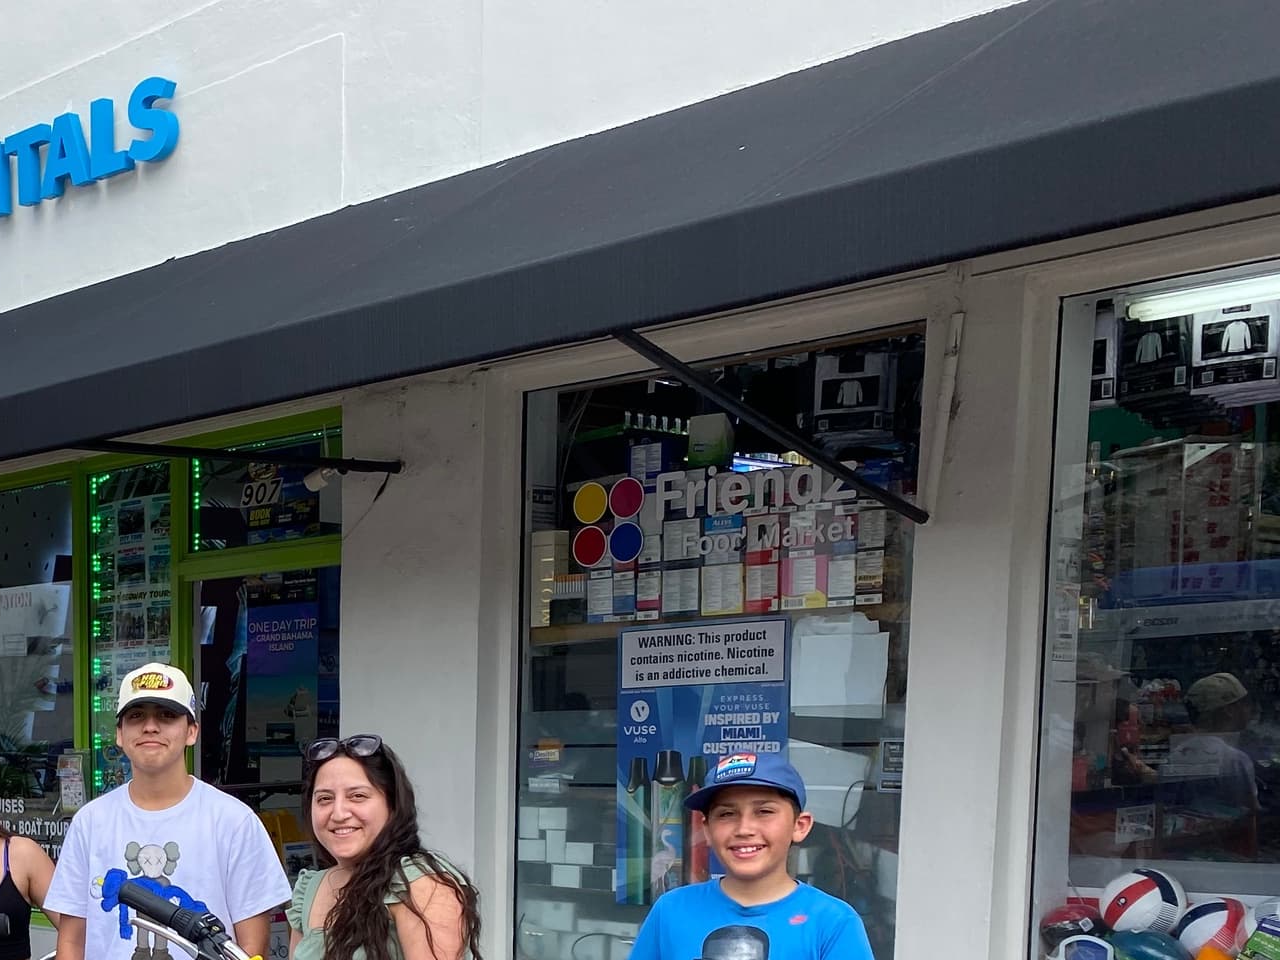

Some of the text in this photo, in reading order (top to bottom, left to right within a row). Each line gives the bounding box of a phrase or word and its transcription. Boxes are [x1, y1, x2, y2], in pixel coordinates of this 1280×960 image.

[244, 479, 281, 506] 907
[656, 460, 857, 520] Friendz
[683, 516, 855, 556] Food Market
[249, 617, 317, 633] ONE DAY TRIP
[256, 631, 313, 642] GRAND BAHAMA
[638, 629, 767, 648] WARNING: This product
[269, 642, 295, 651] ISLAND
[630, 646, 775, 666] contains nicotine. Nicotine
[635, 663, 769, 681] is an addictive chemical.
[720, 694, 764, 702] EXPRESS
[713, 702, 771, 712] YOUR VUSE
[704, 712, 780, 725] INSPIRED BY
[703, 742, 781, 755] CUSTOMIZED
[19, 820, 44, 835] BOAT
